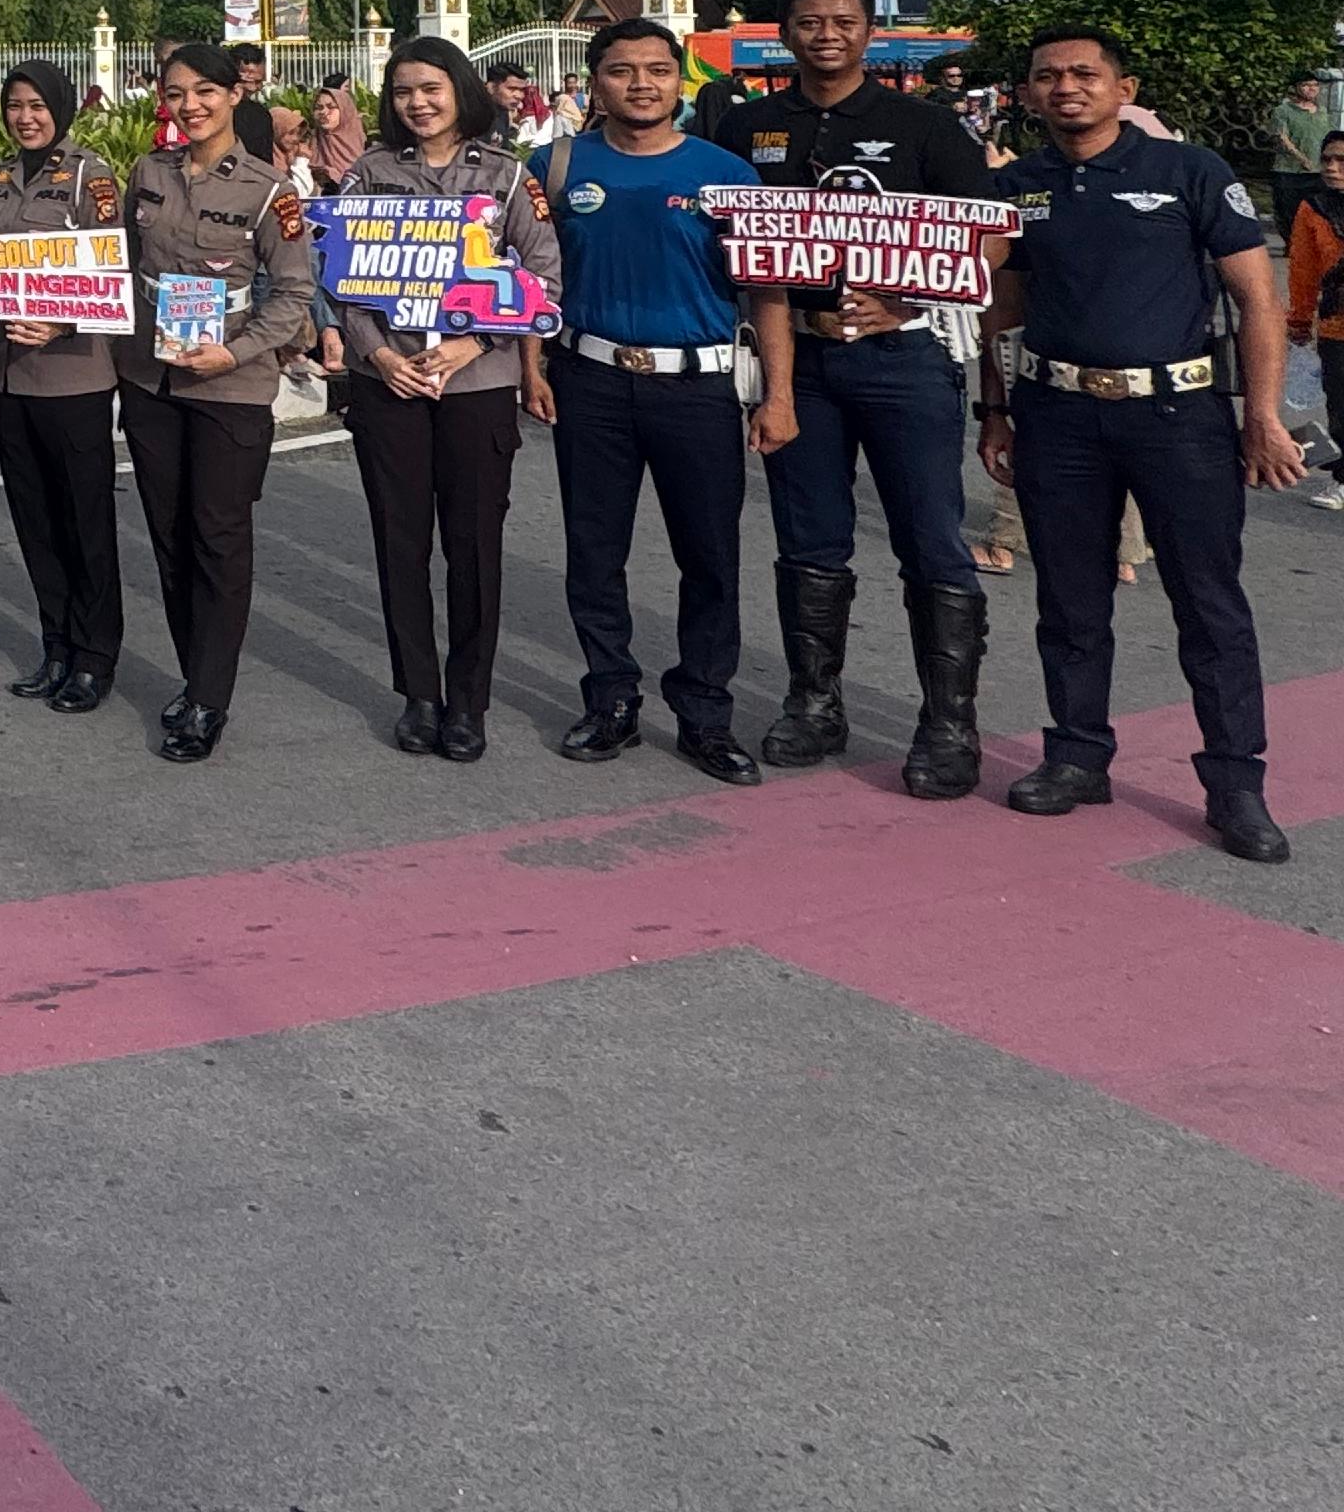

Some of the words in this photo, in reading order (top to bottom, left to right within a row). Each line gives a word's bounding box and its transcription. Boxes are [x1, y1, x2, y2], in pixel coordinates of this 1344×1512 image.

[199, 209, 250, 228] POLRI
[332, 199, 370, 217] JOM
[372, 199, 405, 217] KITE
[408, 200, 429, 217] KE
[432, 200, 463, 217] TPS
[704, 190, 810, 211] SUKSESKAN
[815, 193, 920, 220] KAMPANYE
[925, 202, 1010, 227] PILKADA
[345, 219, 396, 242] YANG
[399, 220, 460, 243] PAKAI
[734, 213, 911, 247] KESELAMATAN
[919, 224, 972, 252] DIRI
[89, 235, 123, 265] YE
[348, 244, 458, 279] MOTOR
[722, 239, 838, 280] TETAP
[846, 245, 980, 297] DIJAGA
[24, 272, 125, 300] NGEBUT
[336, 280, 401, 297] GUNAKAN
[403, 281, 444, 298] HELM
[24, 299, 129, 321] BERHARGA
[394, 298, 439, 328] SNI
